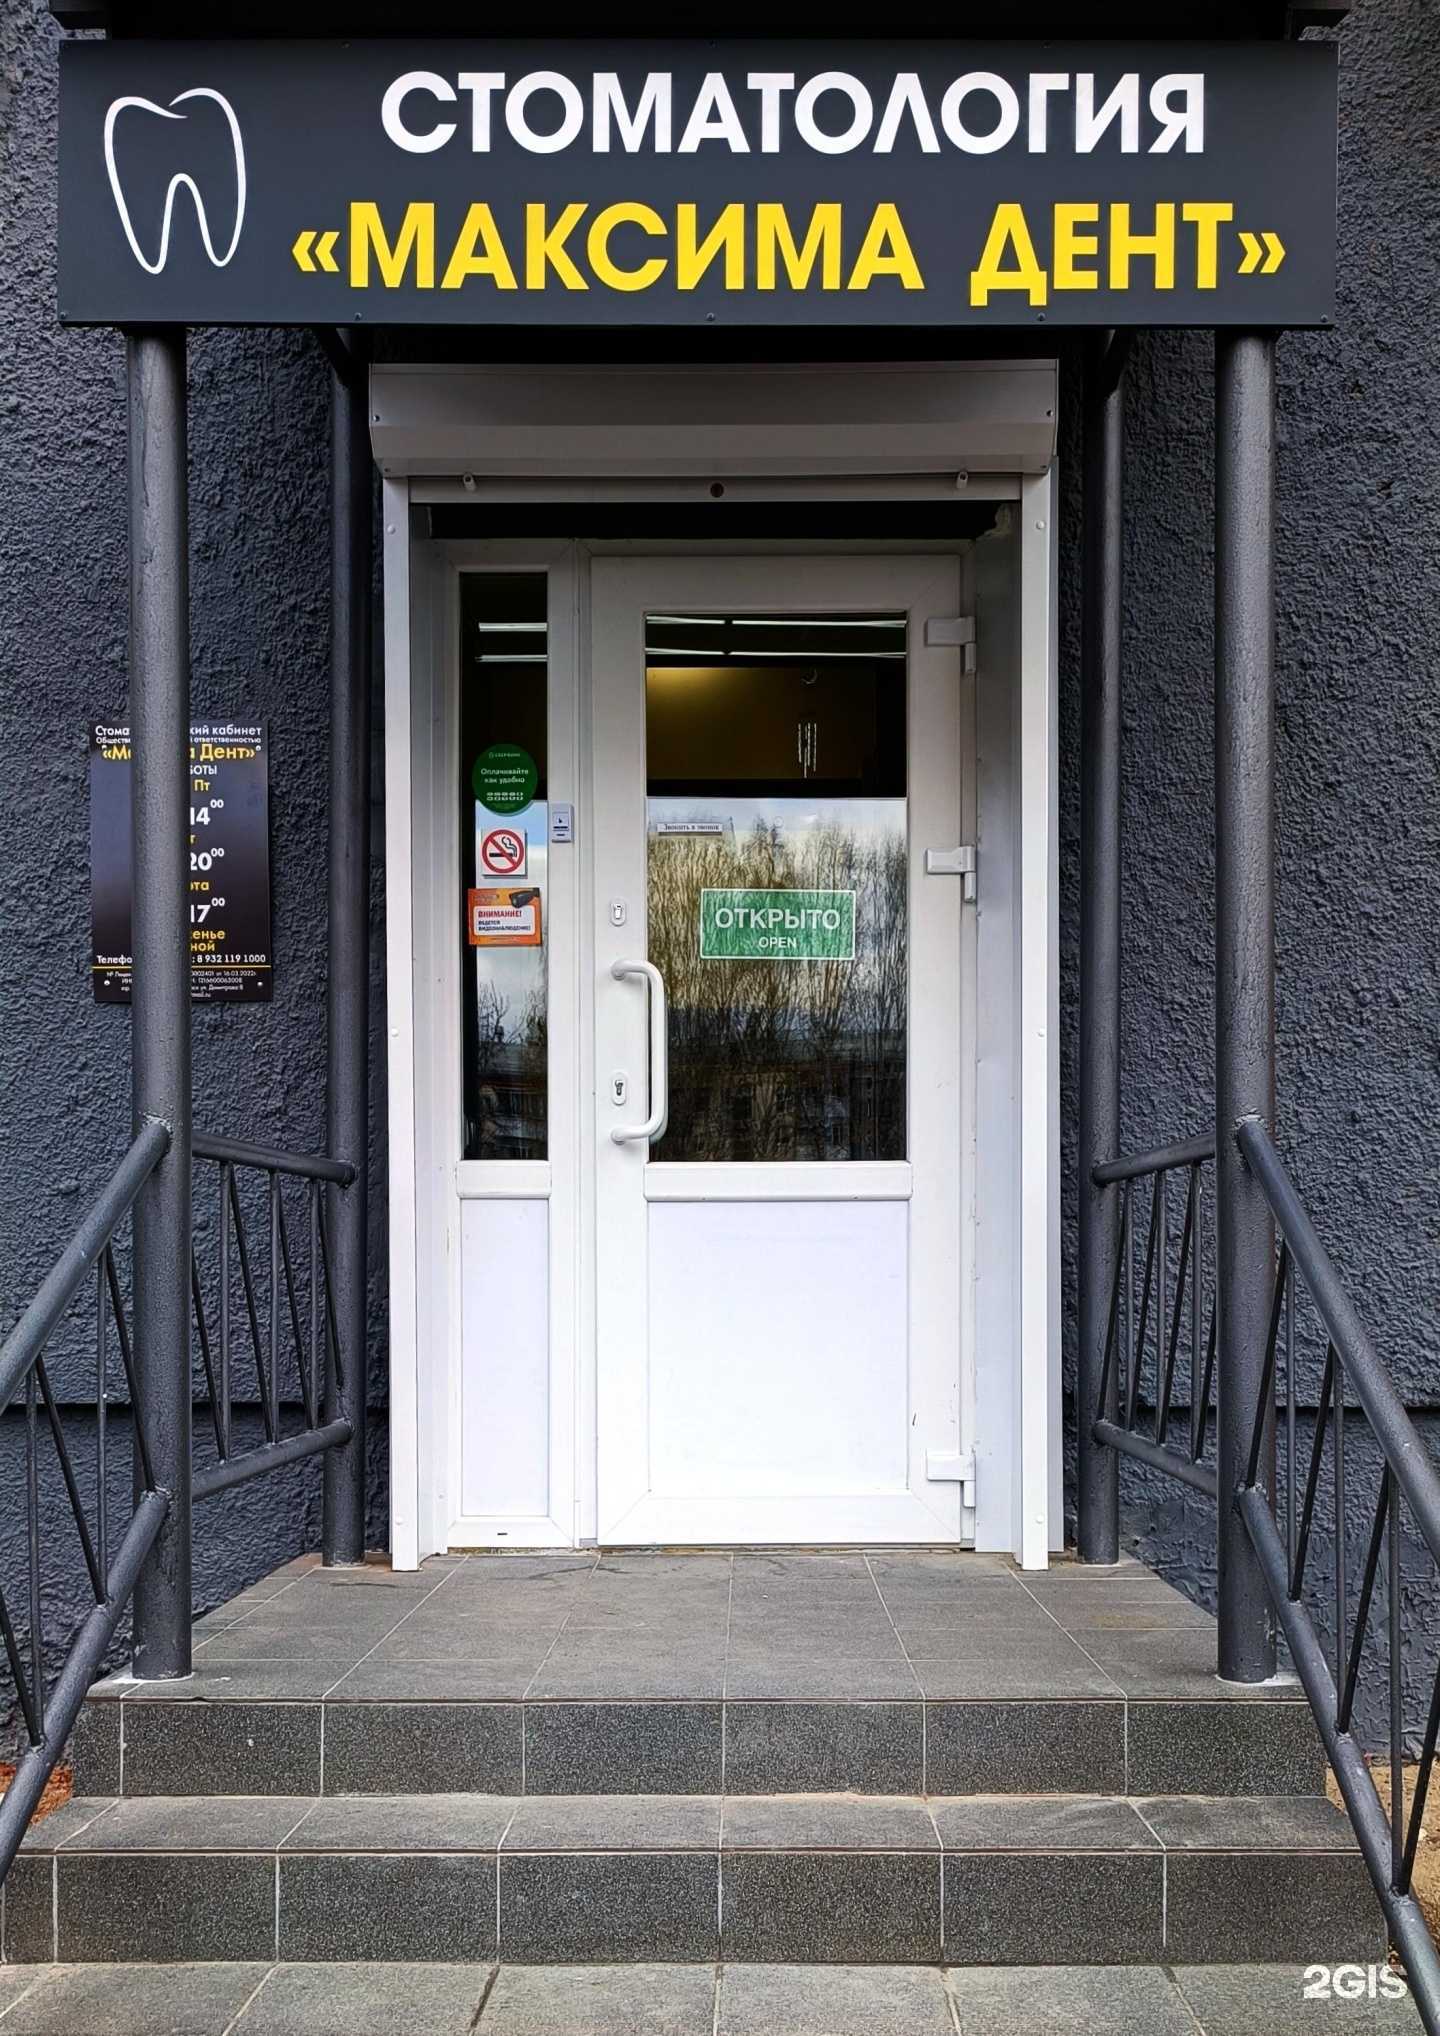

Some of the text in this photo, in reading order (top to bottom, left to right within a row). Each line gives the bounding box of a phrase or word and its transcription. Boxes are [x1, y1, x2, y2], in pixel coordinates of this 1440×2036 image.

[381, 70, 1205, 156] СТОМАТОЛОГИЯ
[291, 202, 1287, 308] «МАКСИМА ДЕНТ»
[212, 724, 262, 735] кабинет
[200, 743, 256, 762] Дент»
[190, 765, 217, 775] ОТЫ
[194, 779, 210, 792] Пт
[478, 909, 522, 918] ВНИМАНИЕ!
[714, 908, 841, 930] ОТКРЫТО
[758, 936, 798, 949] OPEN
[96, 954, 133, 966] Телефо
